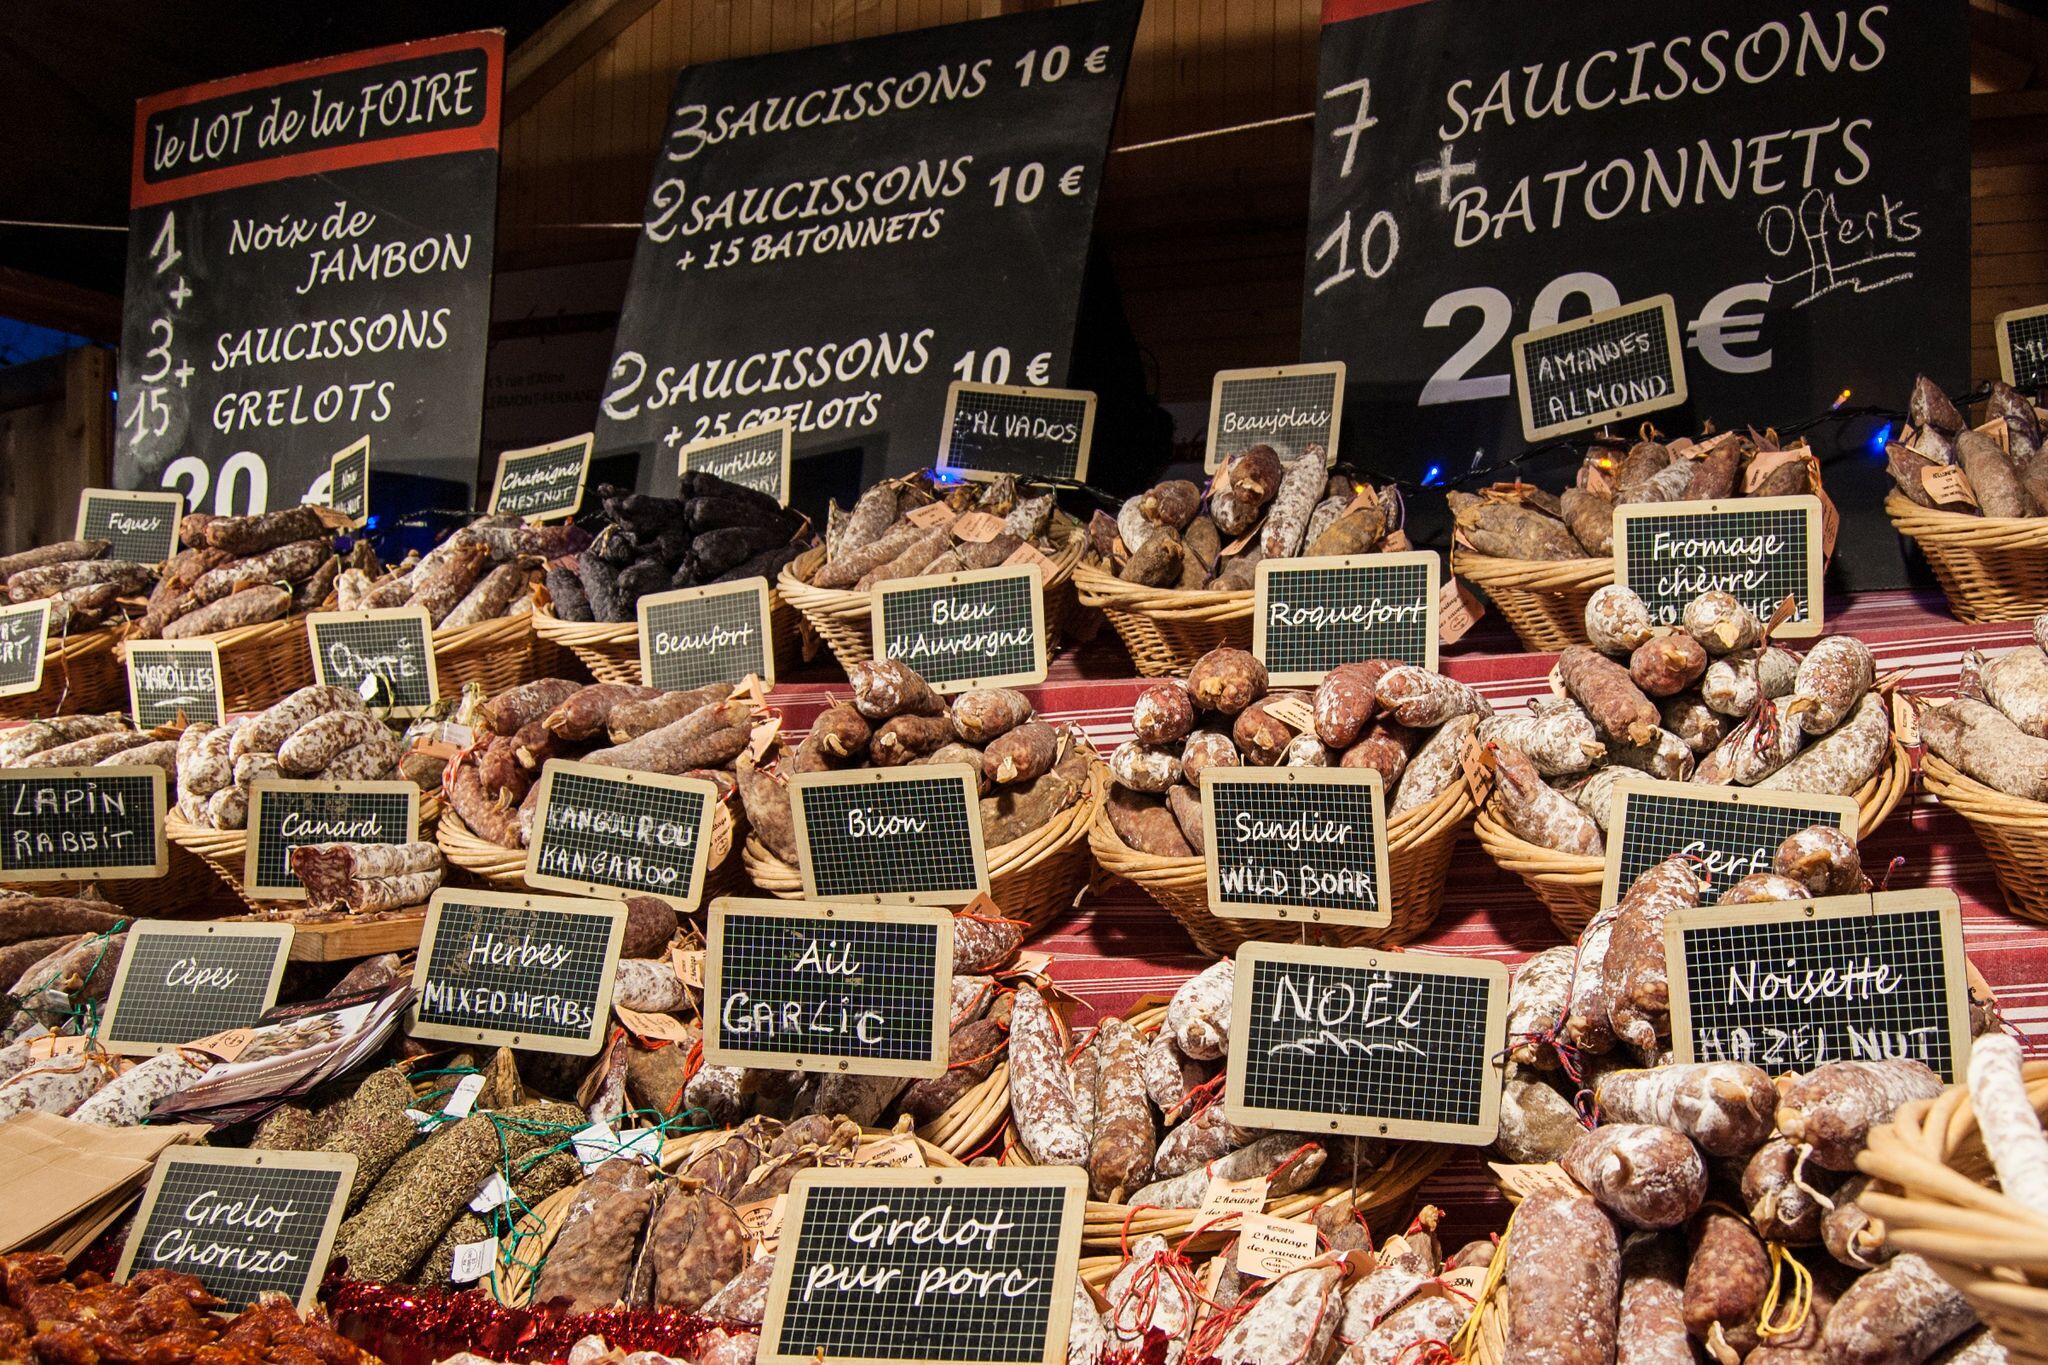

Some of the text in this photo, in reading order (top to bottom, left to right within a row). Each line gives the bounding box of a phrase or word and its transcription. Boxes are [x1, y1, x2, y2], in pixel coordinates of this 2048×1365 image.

[1439, 5, 1890, 141] SAUCISSONS
[153, 67, 478, 172] le LOT de la FOIRE
[667, 44, 1110, 162] 3 SAUCISSONS 10 €
[1323, 77, 1379, 178] 7
[646, 155, 1084, 243] 2 SAUCISSONS 10 €
[1313, 117, 1874, 296] 10 BATONNETS
[150, 201, 376, 275] 1 Noix de
[703, 236, 742, 270] 15
[750, 208, 945, 265] BATONNETS
[296, 233, 472, 295] JAMBON
[141, 318, 174, 384] 3
[212, 308, 452, 373] SAUCISSONS
[1686, 280, 1774, 375] €
[601, 328, 1053, 421] 2 SAUCISSONS 10 €
[124, 381, 395, 447] 15 GRELOTS
[1222, 403, 1332, 436] Beaujolais
[1548, 374, 1668, 424] ALMOND
[694, 415, 732, 444] 25
[698, 448, 777, 479] Myrtilles
[497, 486, 573, 514] CHESTNUT
[107, 511, 162, 536] Figues
[1653, 532, 1785, 564] Fromage
[1657, 563, 1769, 597] chèvre
[931, 598, 996, 625] Bleu
[1270, 597, 1429, 632] Roquefort
[655, 622, 754, 656] Beaufort
[887, 627, 1035, 659] d'Auvergne
[12, 826, 134, 861] RABBIT
[281, 812, 383, 837] Canard
[848, 806, 927, 840] Bison
[1235, 812, 1353, 852] Sanglier
[541, 845, 678, 886] KANGAROO
[1221, 856, 1377, 905] WILD BOAR
[467, 932, 572, 970] Herbes
[793, 938, 860, 976] Ail
[165, 956, 240, 995] Cèpes
[1728, 956, 1903, 1006] Noisette
[422, 979, 507, 1015] MIXED
[512, 991, 593, 1030] HERBS
[1272, 970, 1424, 1029] NOËL
[186, 1190, 298, 1234] Grelot
[848, 1205, 1015, 1251] Grelot
[154, 1228, 300, 1273] Chorizo
[1251, 1232, 1309, 1248] L'héritage
[1269, 1249, 1313, 1262] saveurs
[803, 1260, 1039, 1308] pur porc
